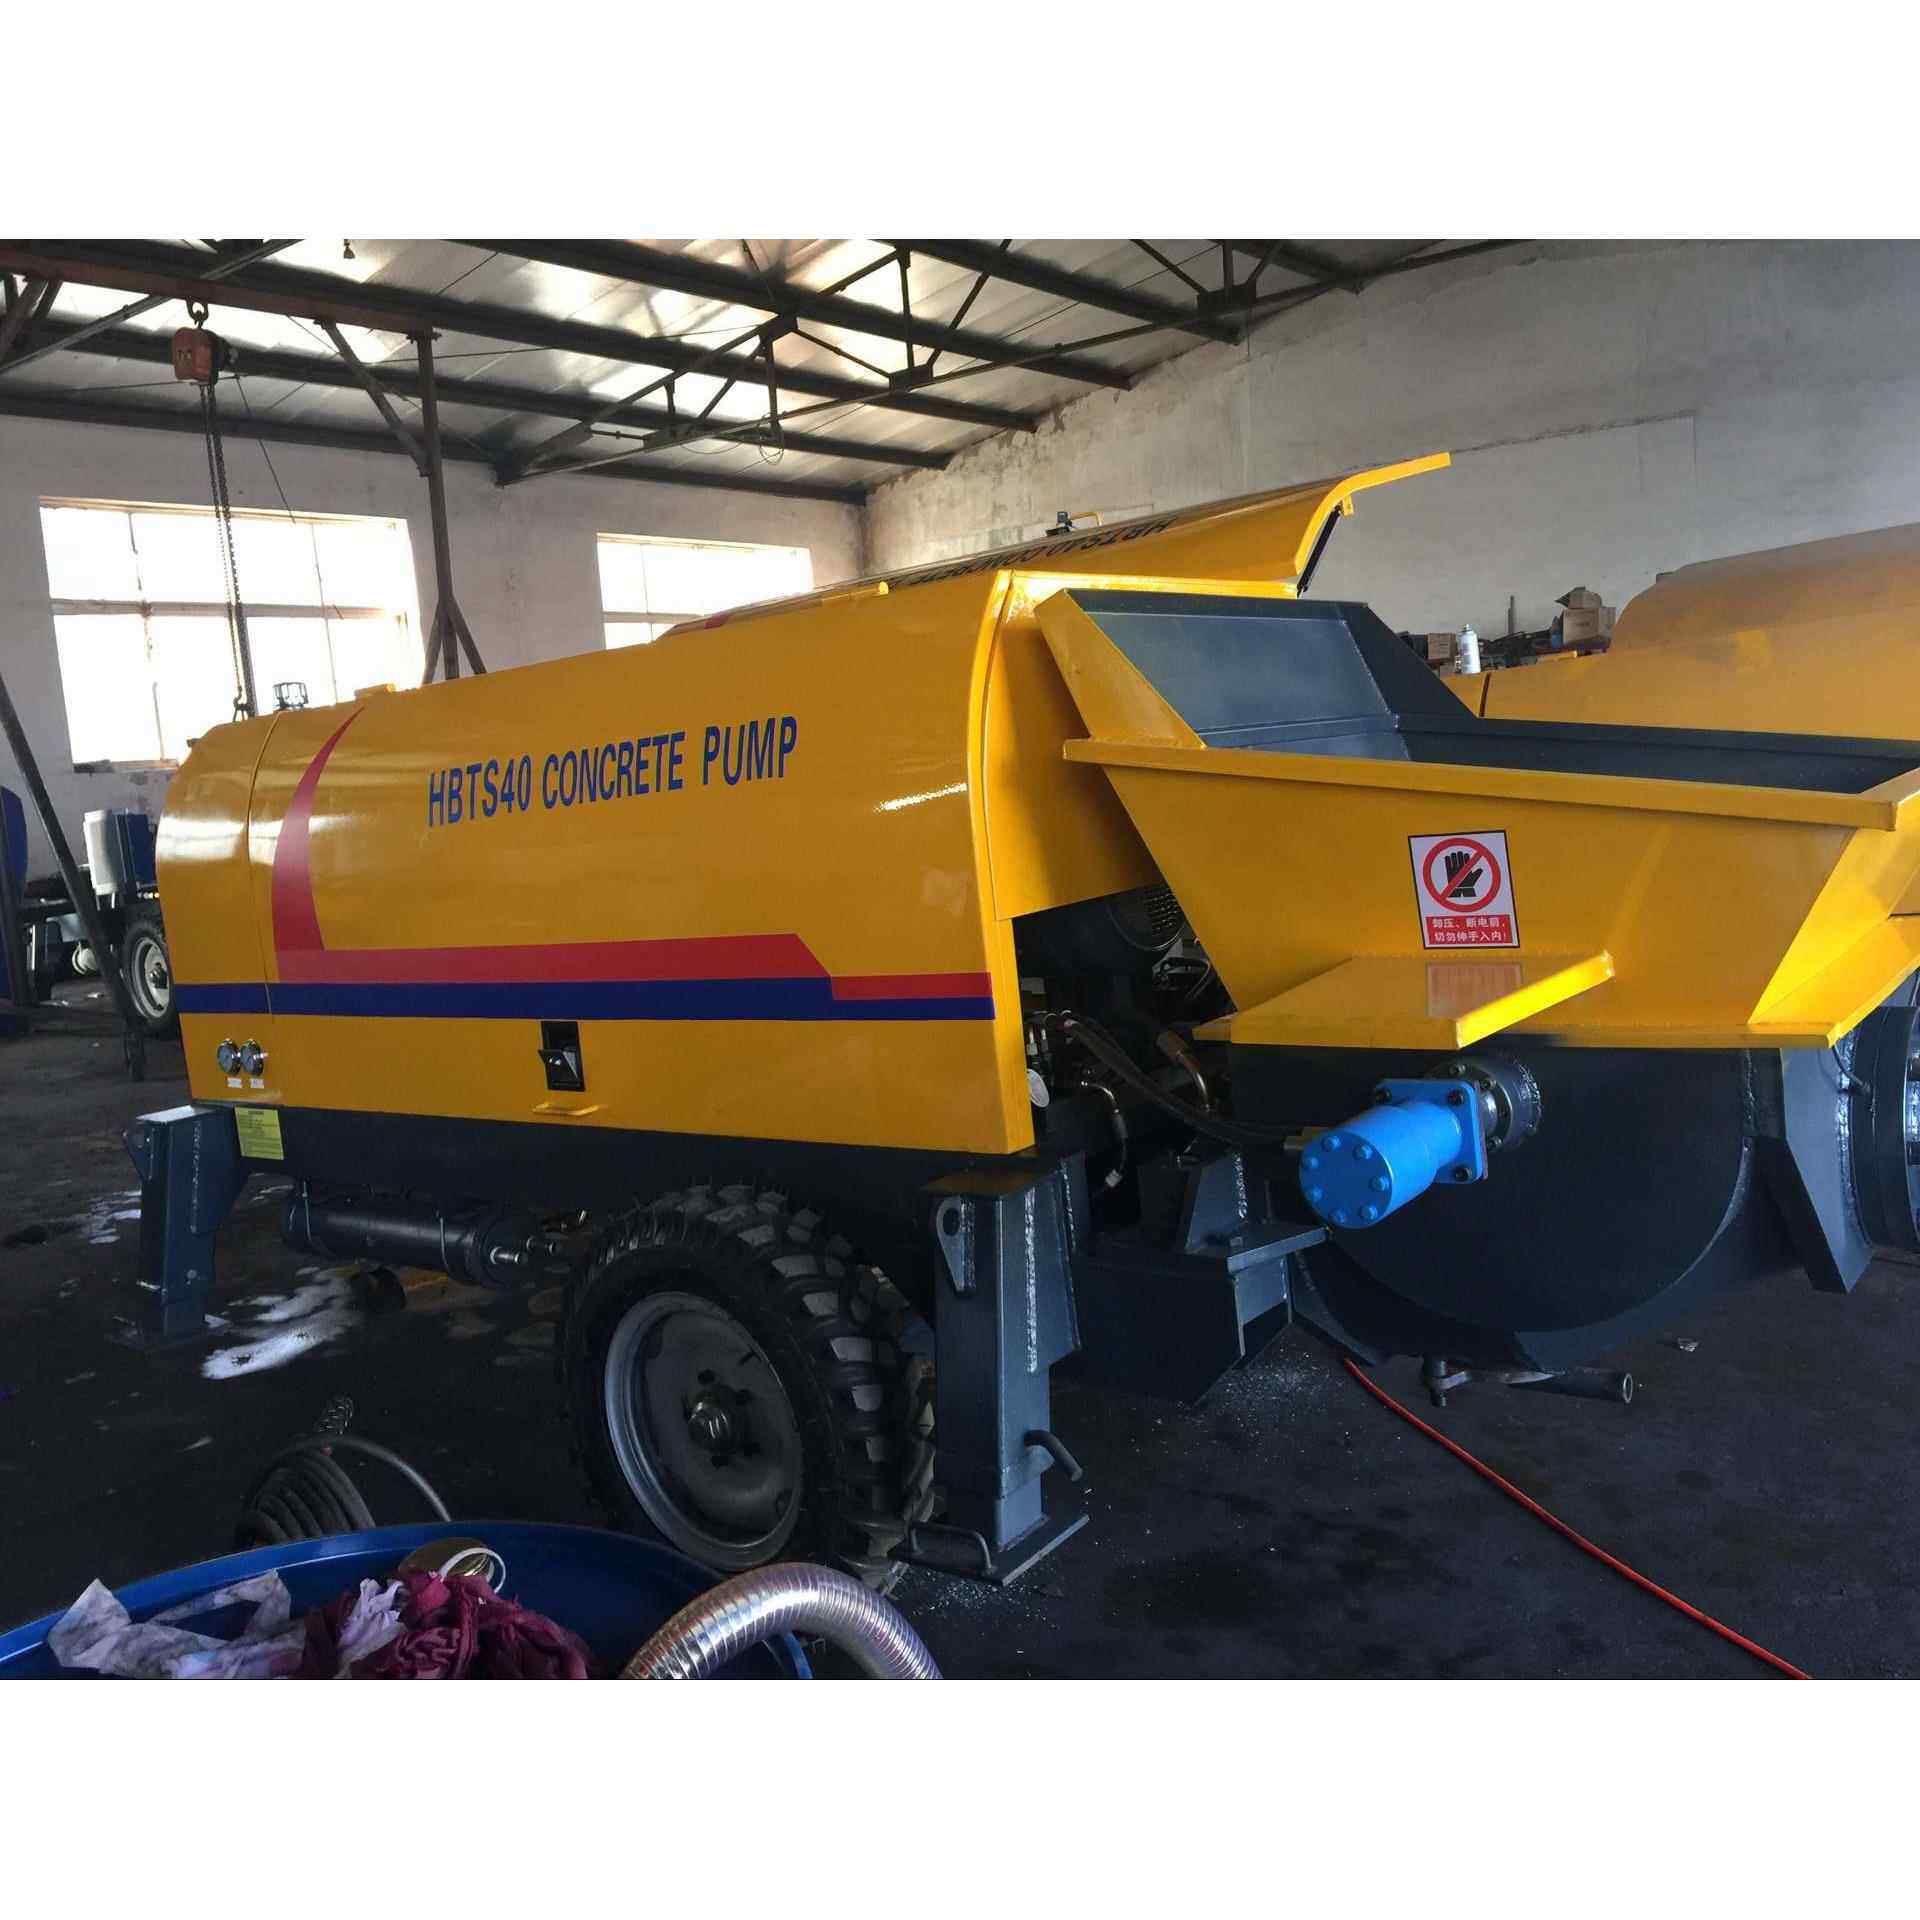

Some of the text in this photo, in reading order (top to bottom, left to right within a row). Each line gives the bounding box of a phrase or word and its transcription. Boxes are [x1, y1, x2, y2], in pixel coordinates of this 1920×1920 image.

[428, 715, 798, 827] HBTS40 CONCRETE PUMP
